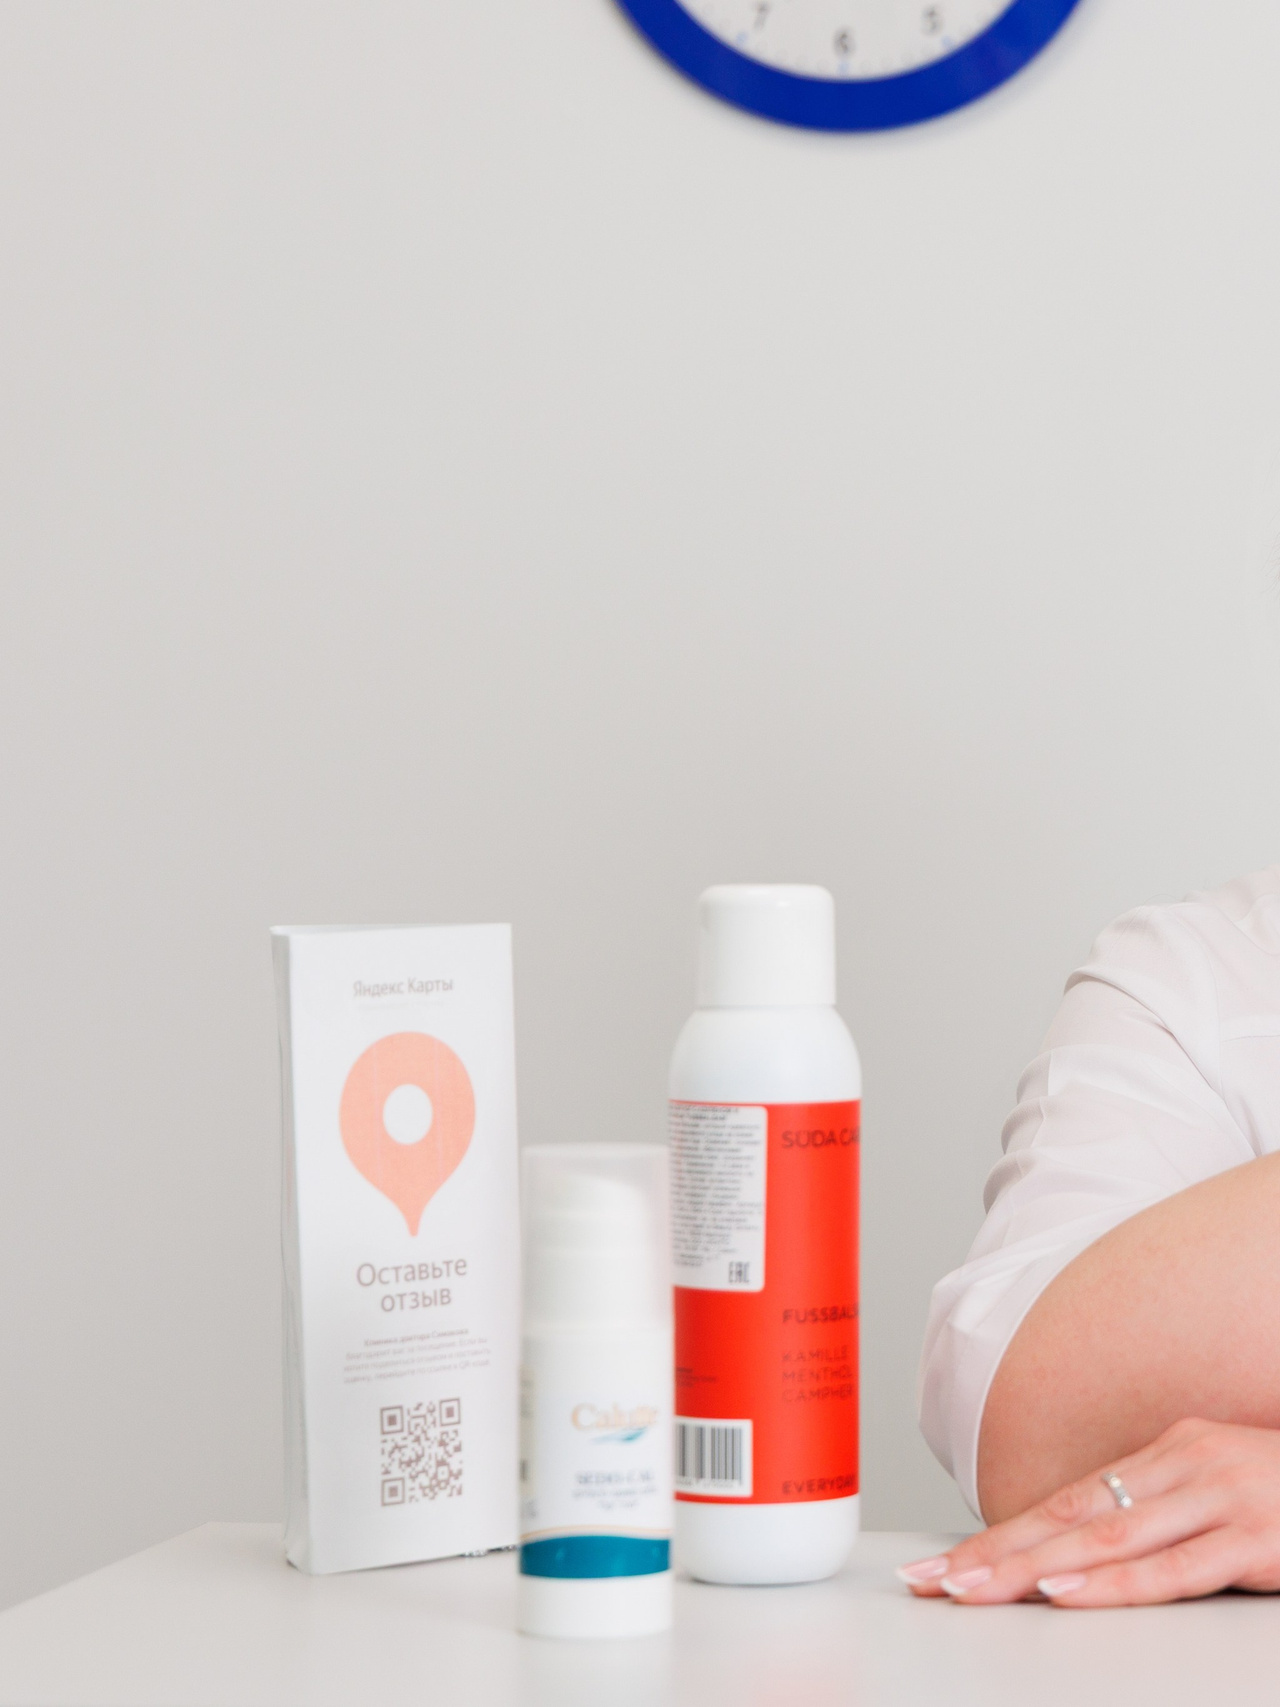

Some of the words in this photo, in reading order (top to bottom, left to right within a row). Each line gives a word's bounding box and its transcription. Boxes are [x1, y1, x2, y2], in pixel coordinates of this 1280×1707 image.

[353, 980, 404, 997] Яндекс
[407, 976, 454, 996] Карты
[356, 1258, 468, 1286] Оставьте
[381, 1288, 452, 1312] отзыв
[782, 1364, 852, 1382] MENTHOL
